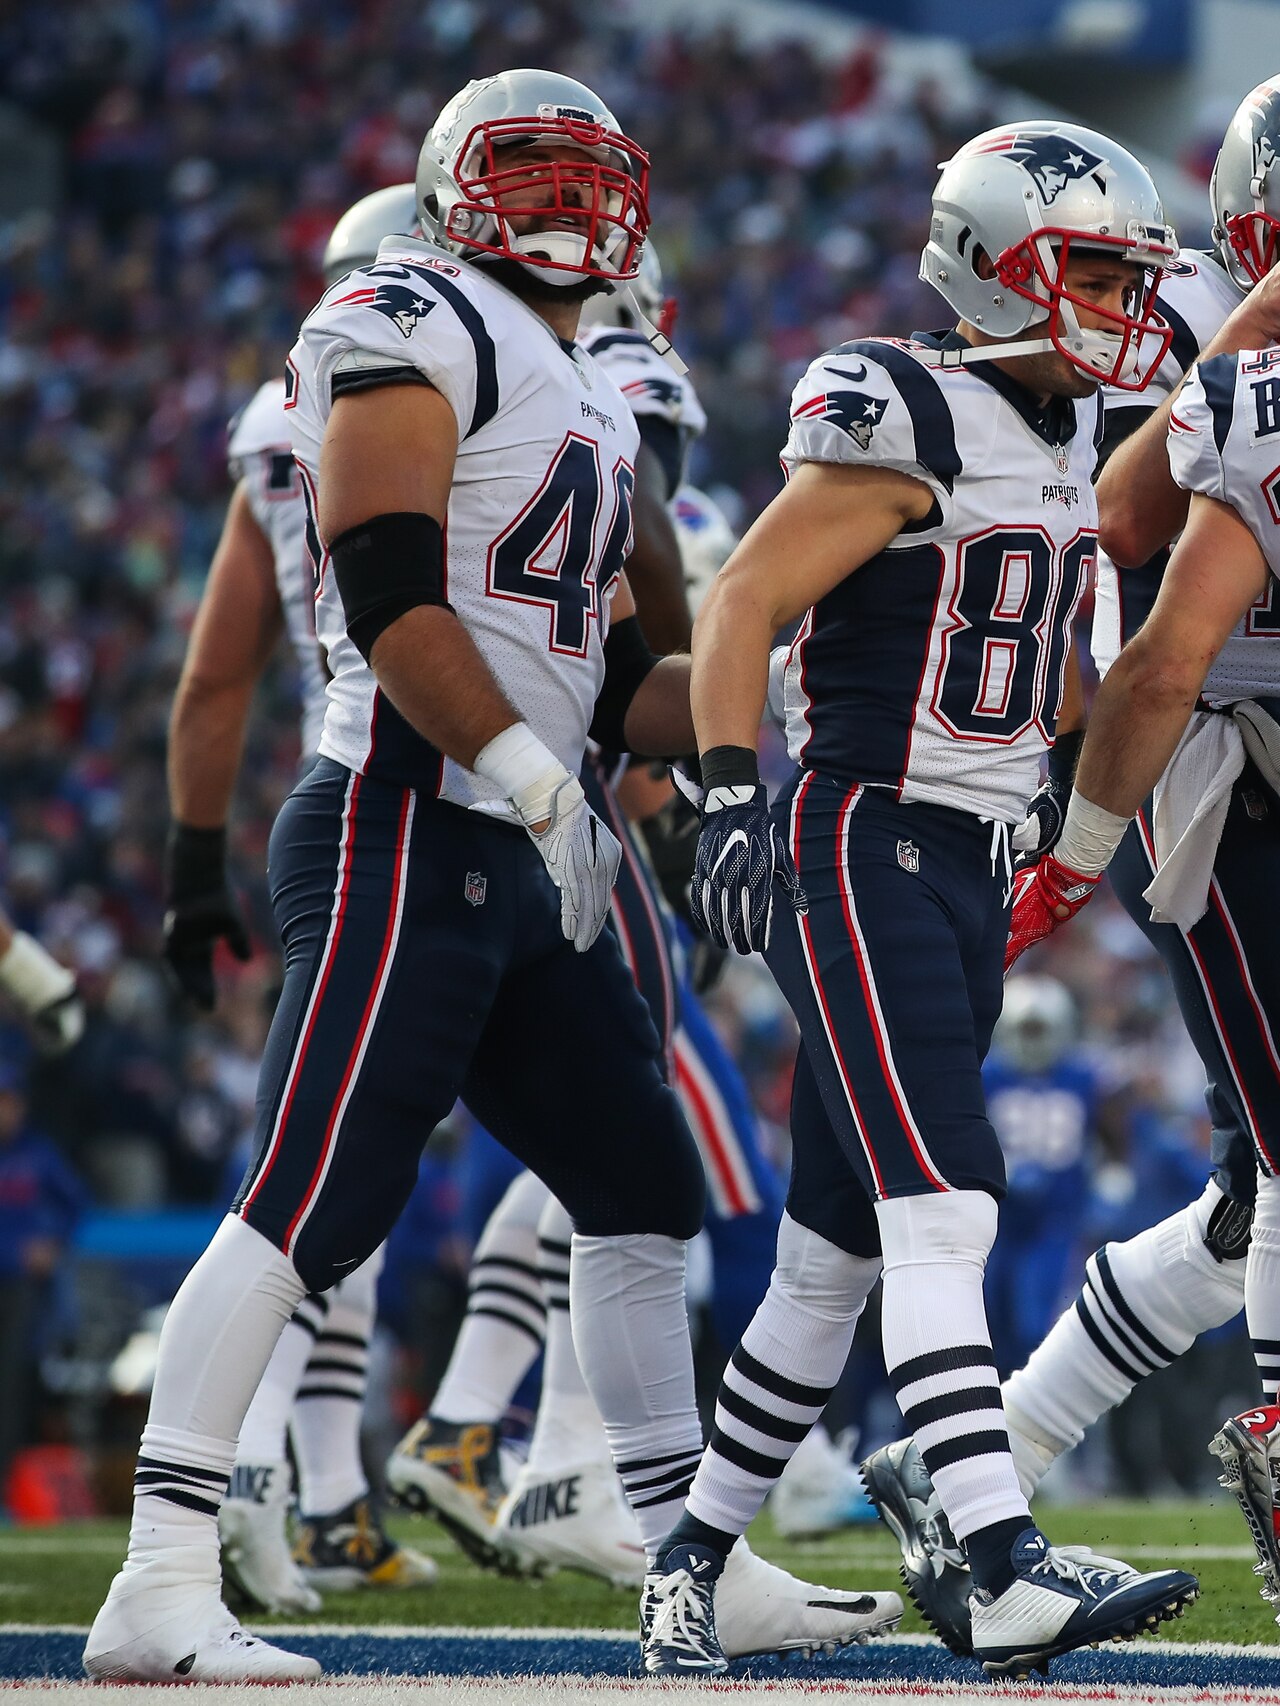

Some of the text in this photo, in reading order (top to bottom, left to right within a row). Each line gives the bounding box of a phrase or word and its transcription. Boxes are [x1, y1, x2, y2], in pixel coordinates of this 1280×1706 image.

[580, 401, 616, 431] PATRIOTS
[1042, 485, 1079, 504] PATRIOTS
[900, 853, 916, 870] NFL
[1240, 1412, 1267, 1429] 2
[510, 1476, 581, 1527] NIKE
